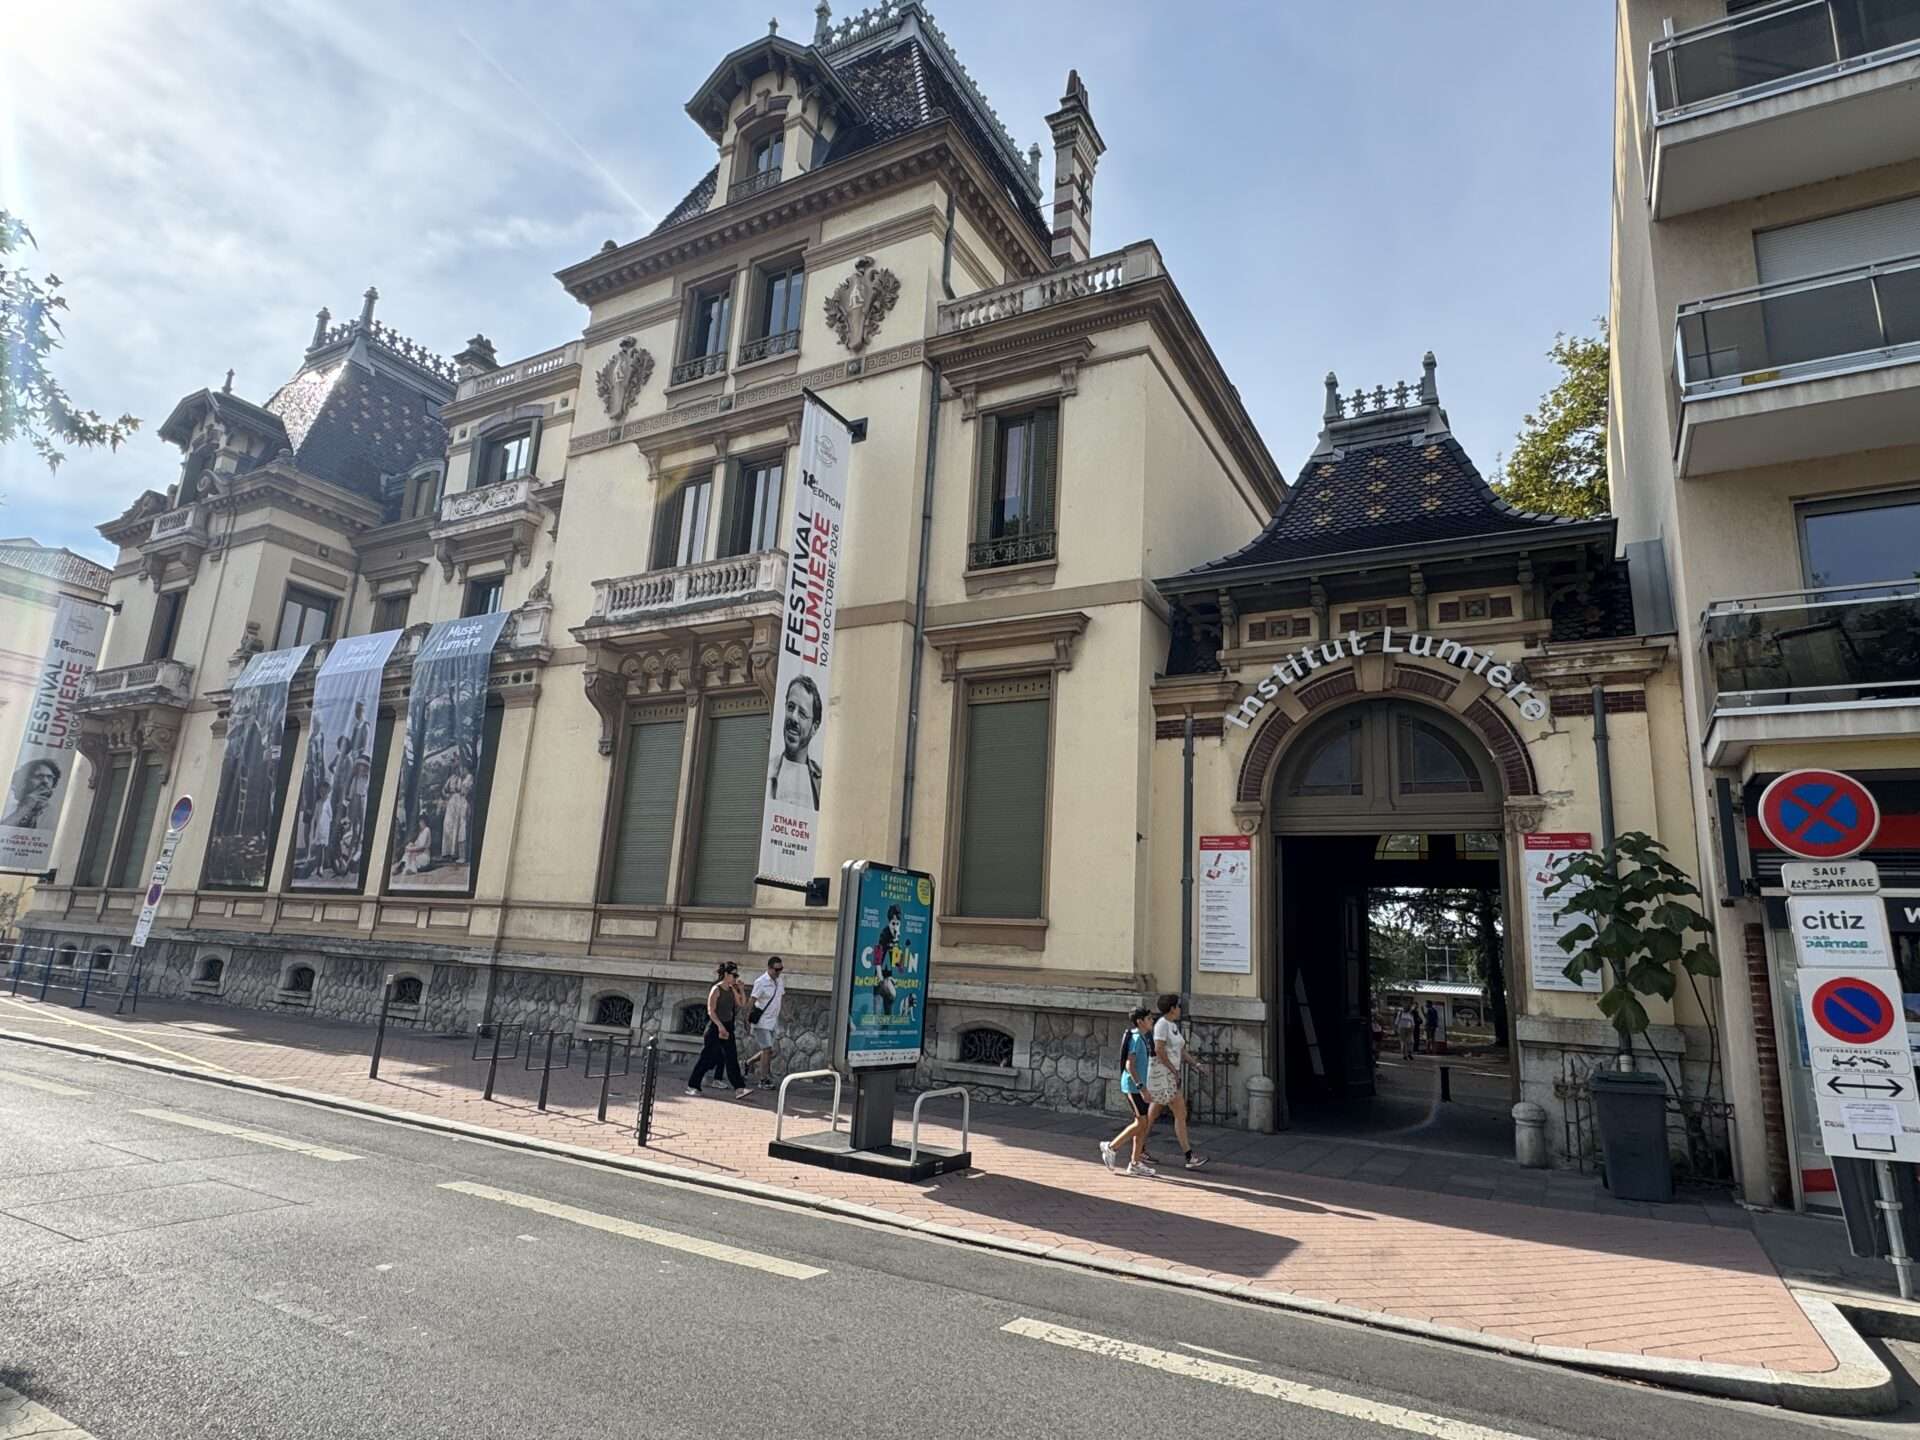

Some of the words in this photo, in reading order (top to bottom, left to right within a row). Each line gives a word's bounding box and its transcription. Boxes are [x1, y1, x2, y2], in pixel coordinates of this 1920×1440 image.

[830, 523, 841, 557] 2026
[785, 510, 813, 657] FESTIVAL
[803, 511, 831, 665] LUMIÈRE
[824, 558, 837, 631] OCTOBRE
[27, 659, 65, 748] FESTIVAL
[1226, 628, 1367, 730] Institut
[1382, 626, 1547, 721] Lumière
[791, 828, 810, 840] COEN
[1812, 867, 1847, 876] SAUF
[1802, 910, 1865, 930] citiz
